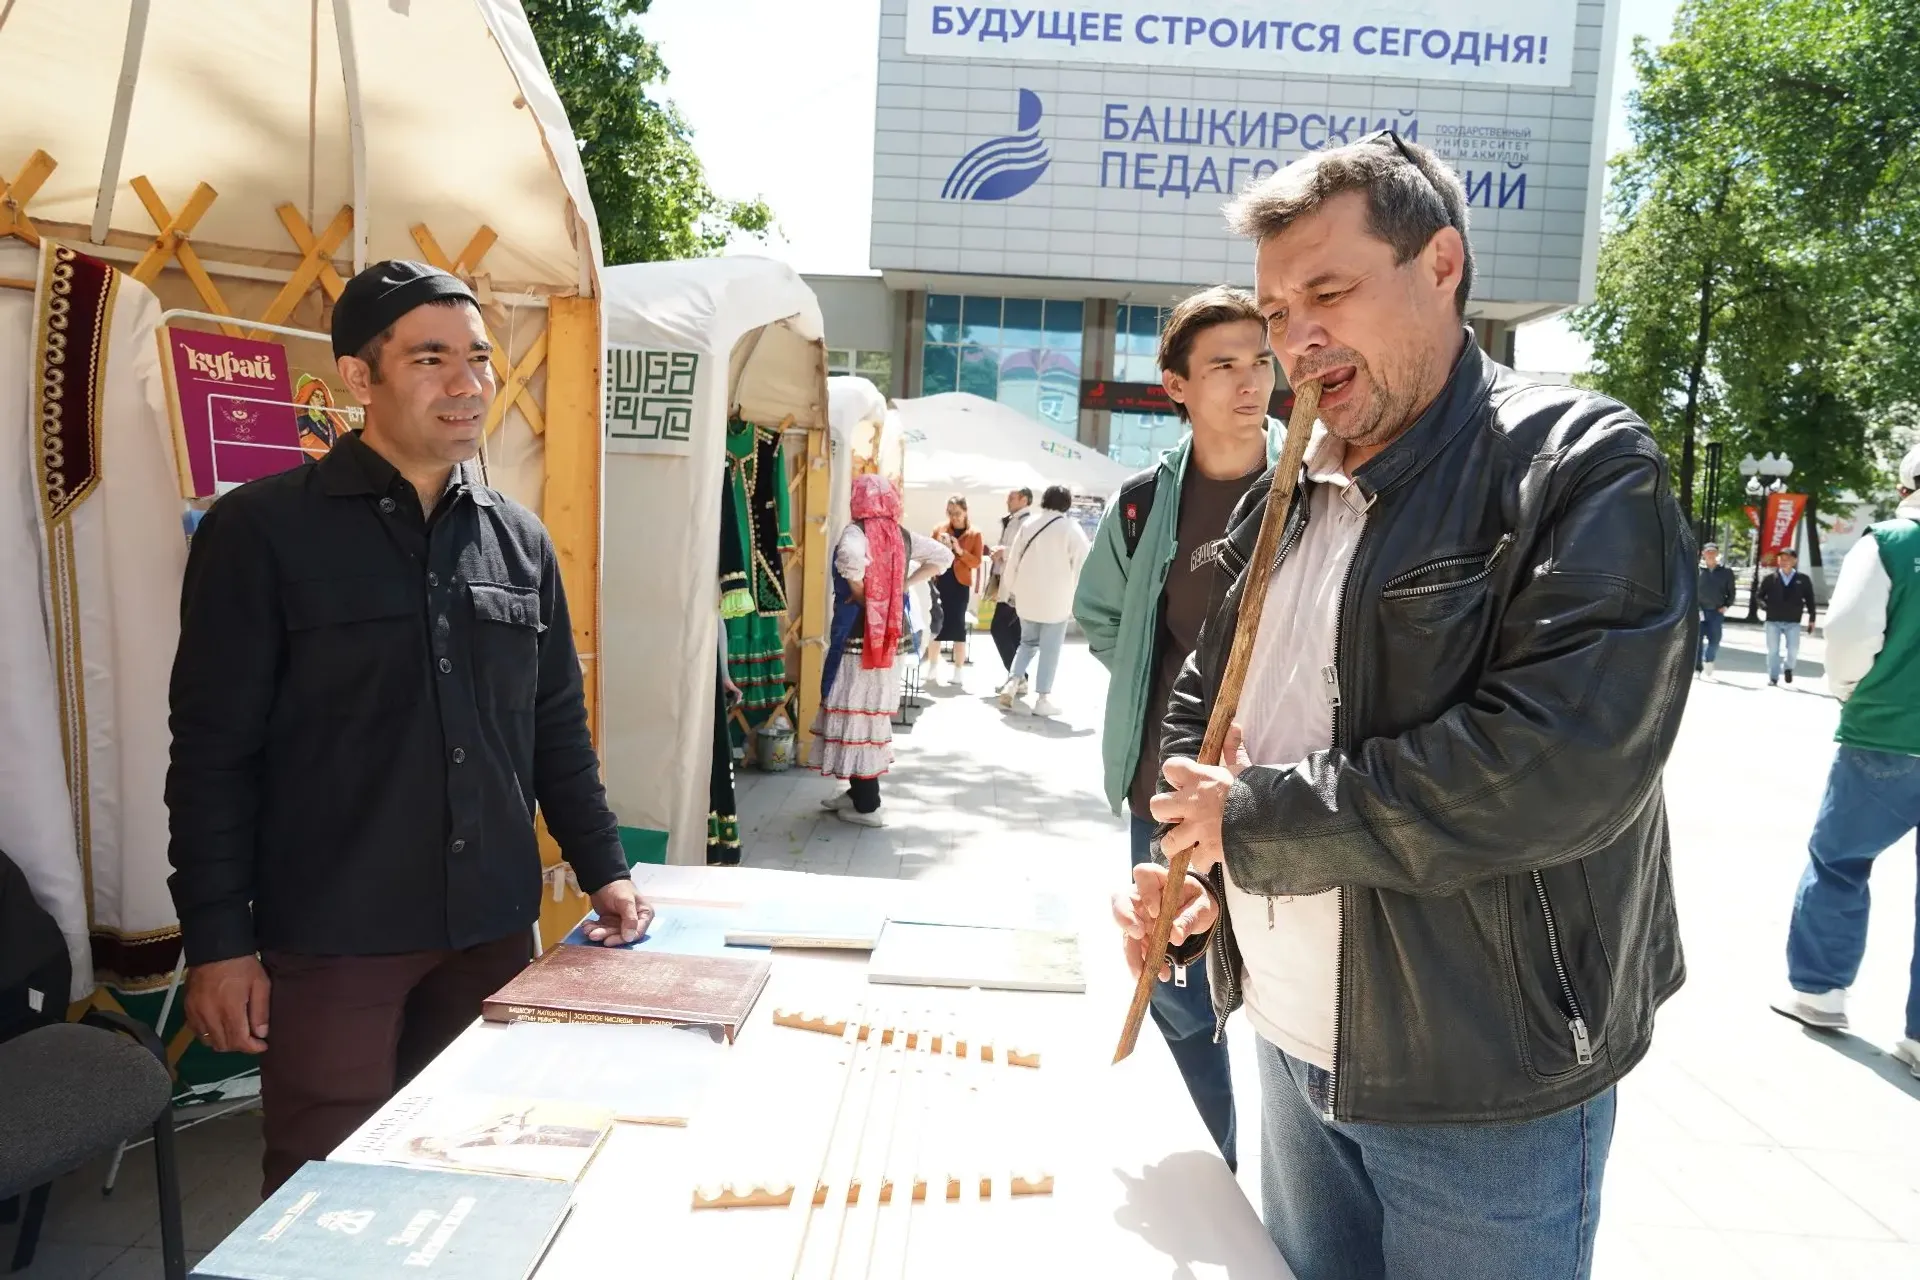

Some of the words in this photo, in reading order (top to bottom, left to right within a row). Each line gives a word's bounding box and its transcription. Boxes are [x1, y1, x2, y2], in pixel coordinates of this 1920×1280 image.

[932, 6, 1122, 46] БУДУЩЕЕ
[1135, 14, 1340, 53] СТРОИТСЯ
[1353, 25, 1548, 66] СЕГОДНЯ!
[1435, 125, 1531, 138] ГОСУДАРСТВЕННЫЙ
[1435, 138, 1530, 150] УНИВЕРСИТЕТ
[1472, 151, 1529, 161] АКМУЛЛЫ
[574, 1012, 603, 1021] ЗОЛОТОЕ
